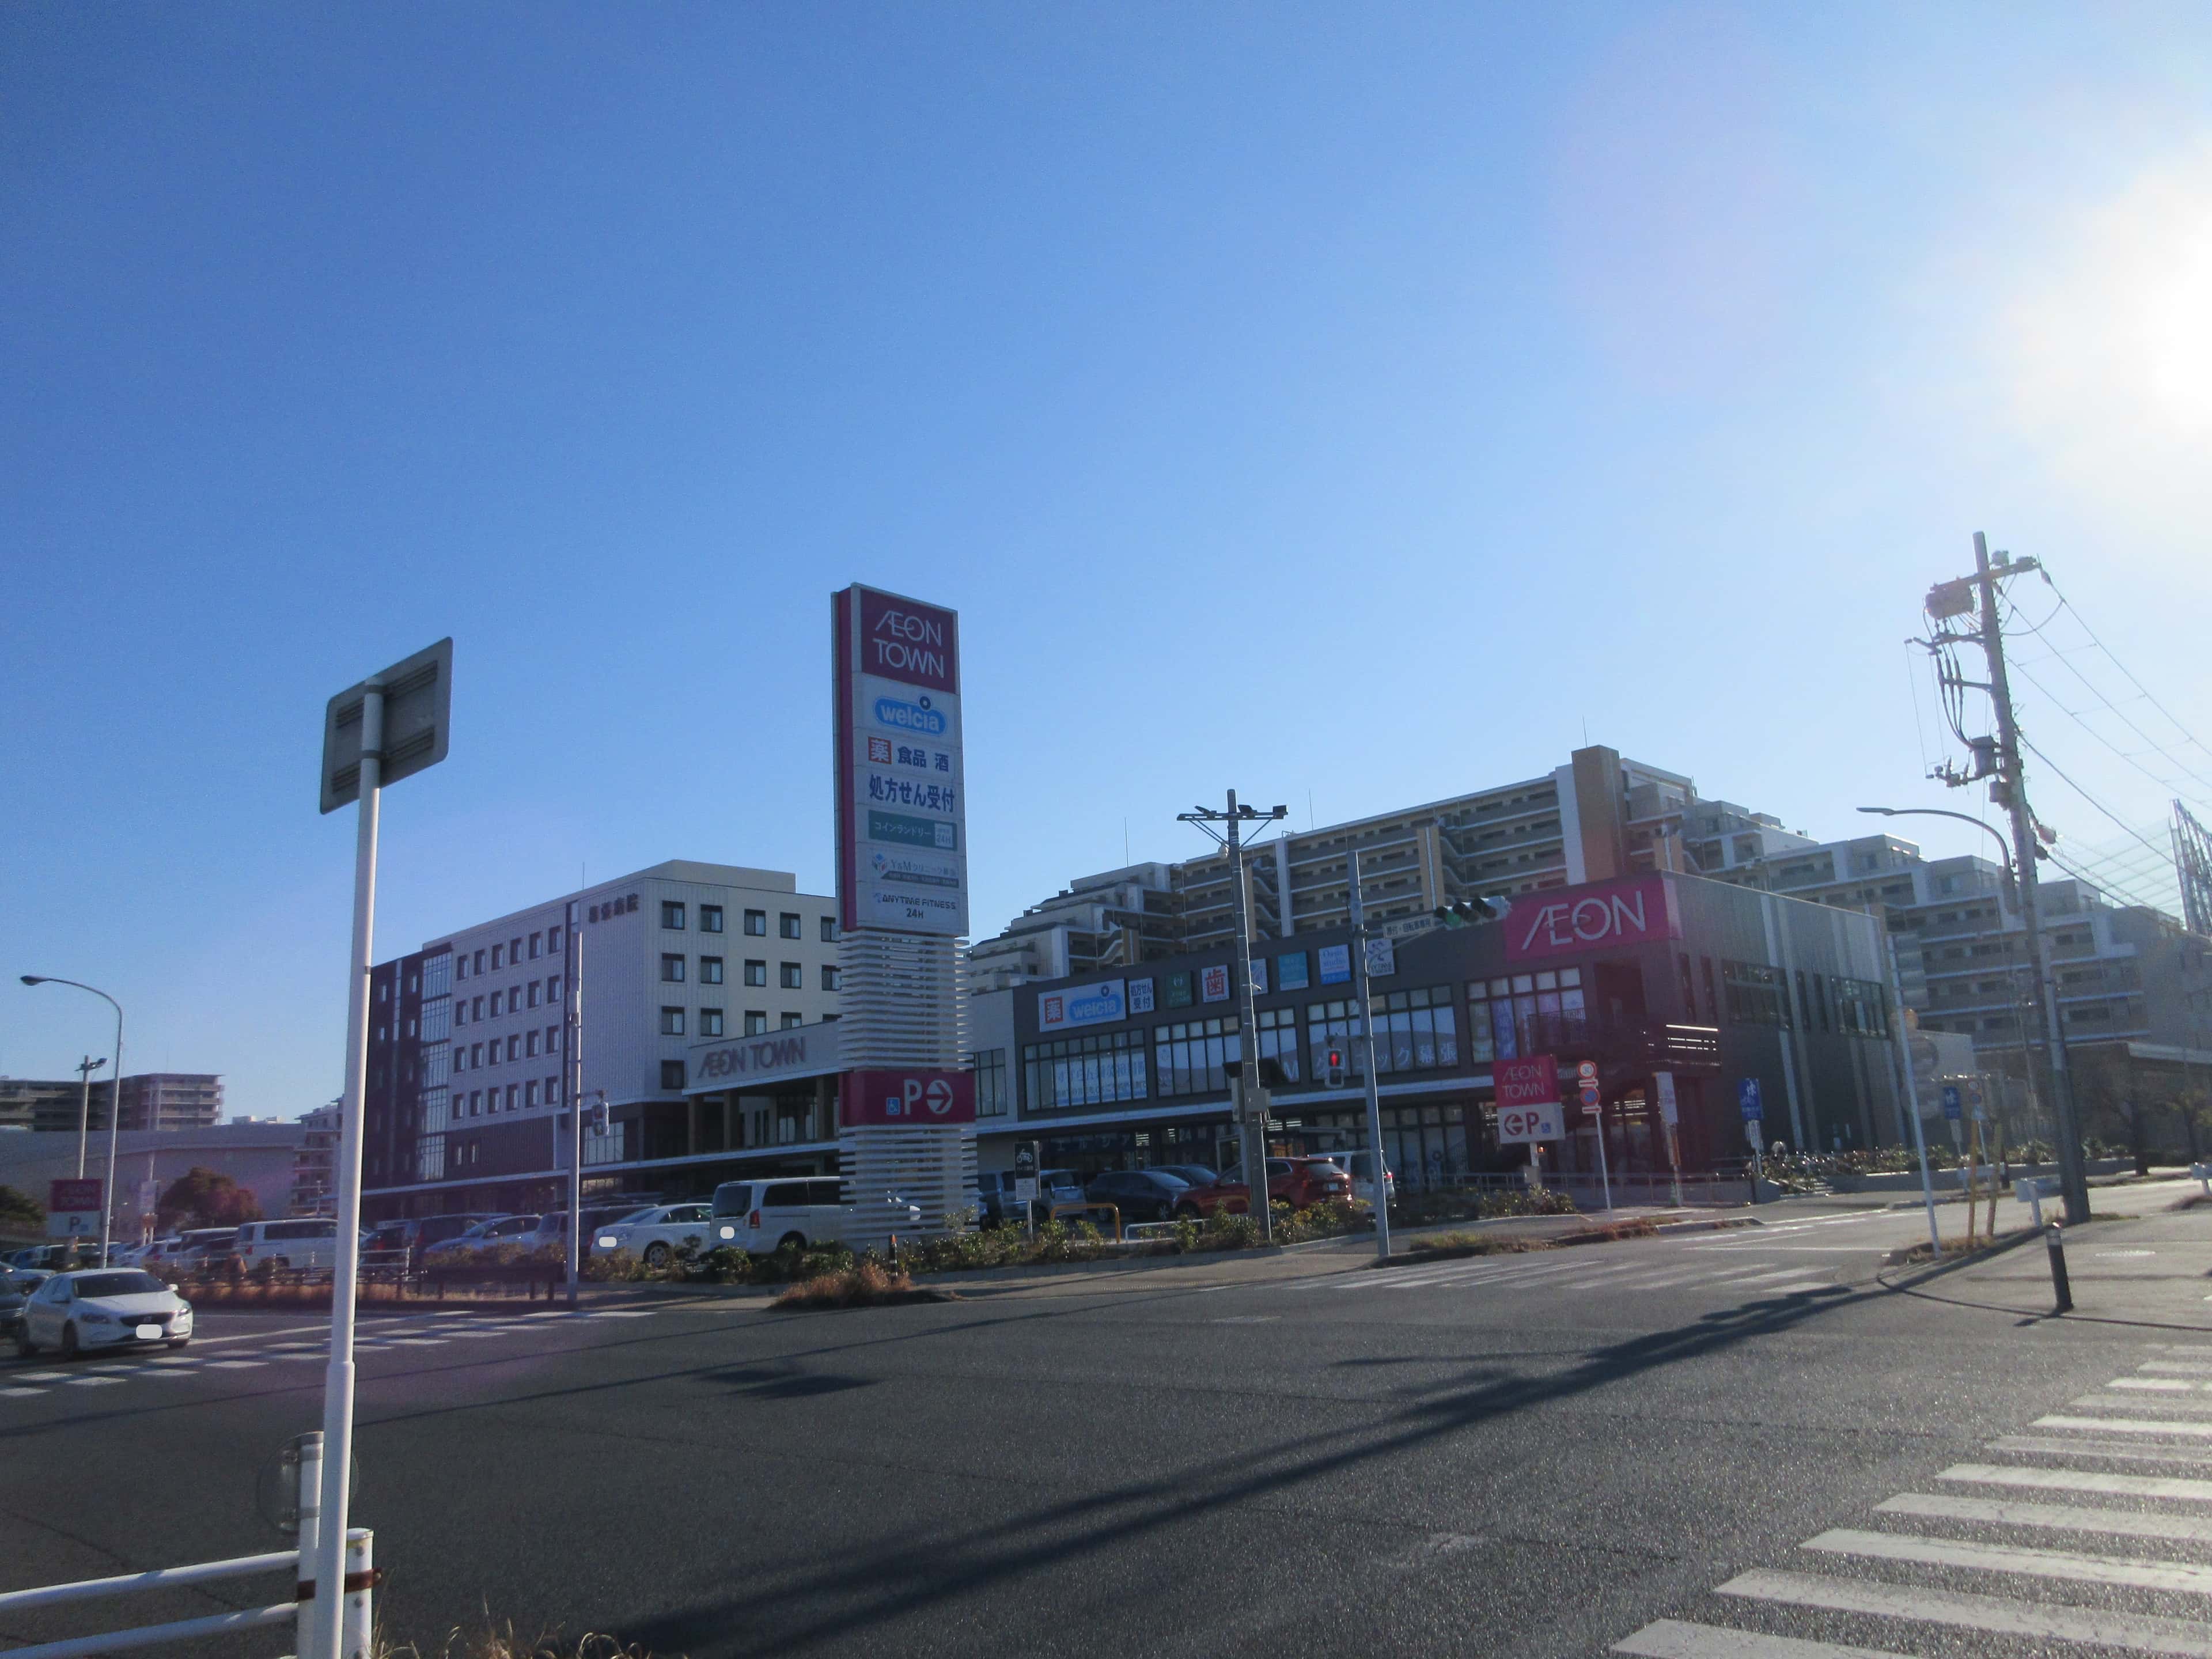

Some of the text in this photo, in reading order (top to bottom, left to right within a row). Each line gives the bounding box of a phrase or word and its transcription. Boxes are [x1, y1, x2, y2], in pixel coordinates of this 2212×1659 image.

[872, 638, 945, 678] TOWN
[880, 697, 940, 732] welcia
[870, 738, 949, 772] 薬 食品 酒
[869, 774, 955, 813] 処方せん受付
[874, 822, 932, 837] コインランドリー
[882, 894, 957, 910] ANYTIME FITNESS
[906, 908, 924, 919] 24H
[1206, 968, 1225, 996] 歯
[1073, 991, 1116, 1019] welcia
[1133, 997, 1151, 1010] 受付
[749, 1036, 806, 1070] TOWN
[903, 1078, 922, 1115] P
[1502, 1082, 1544, 1098] TOWN
[1525, 1112, 1540, 1134] P
[69, 1216, 81, 1232] P
